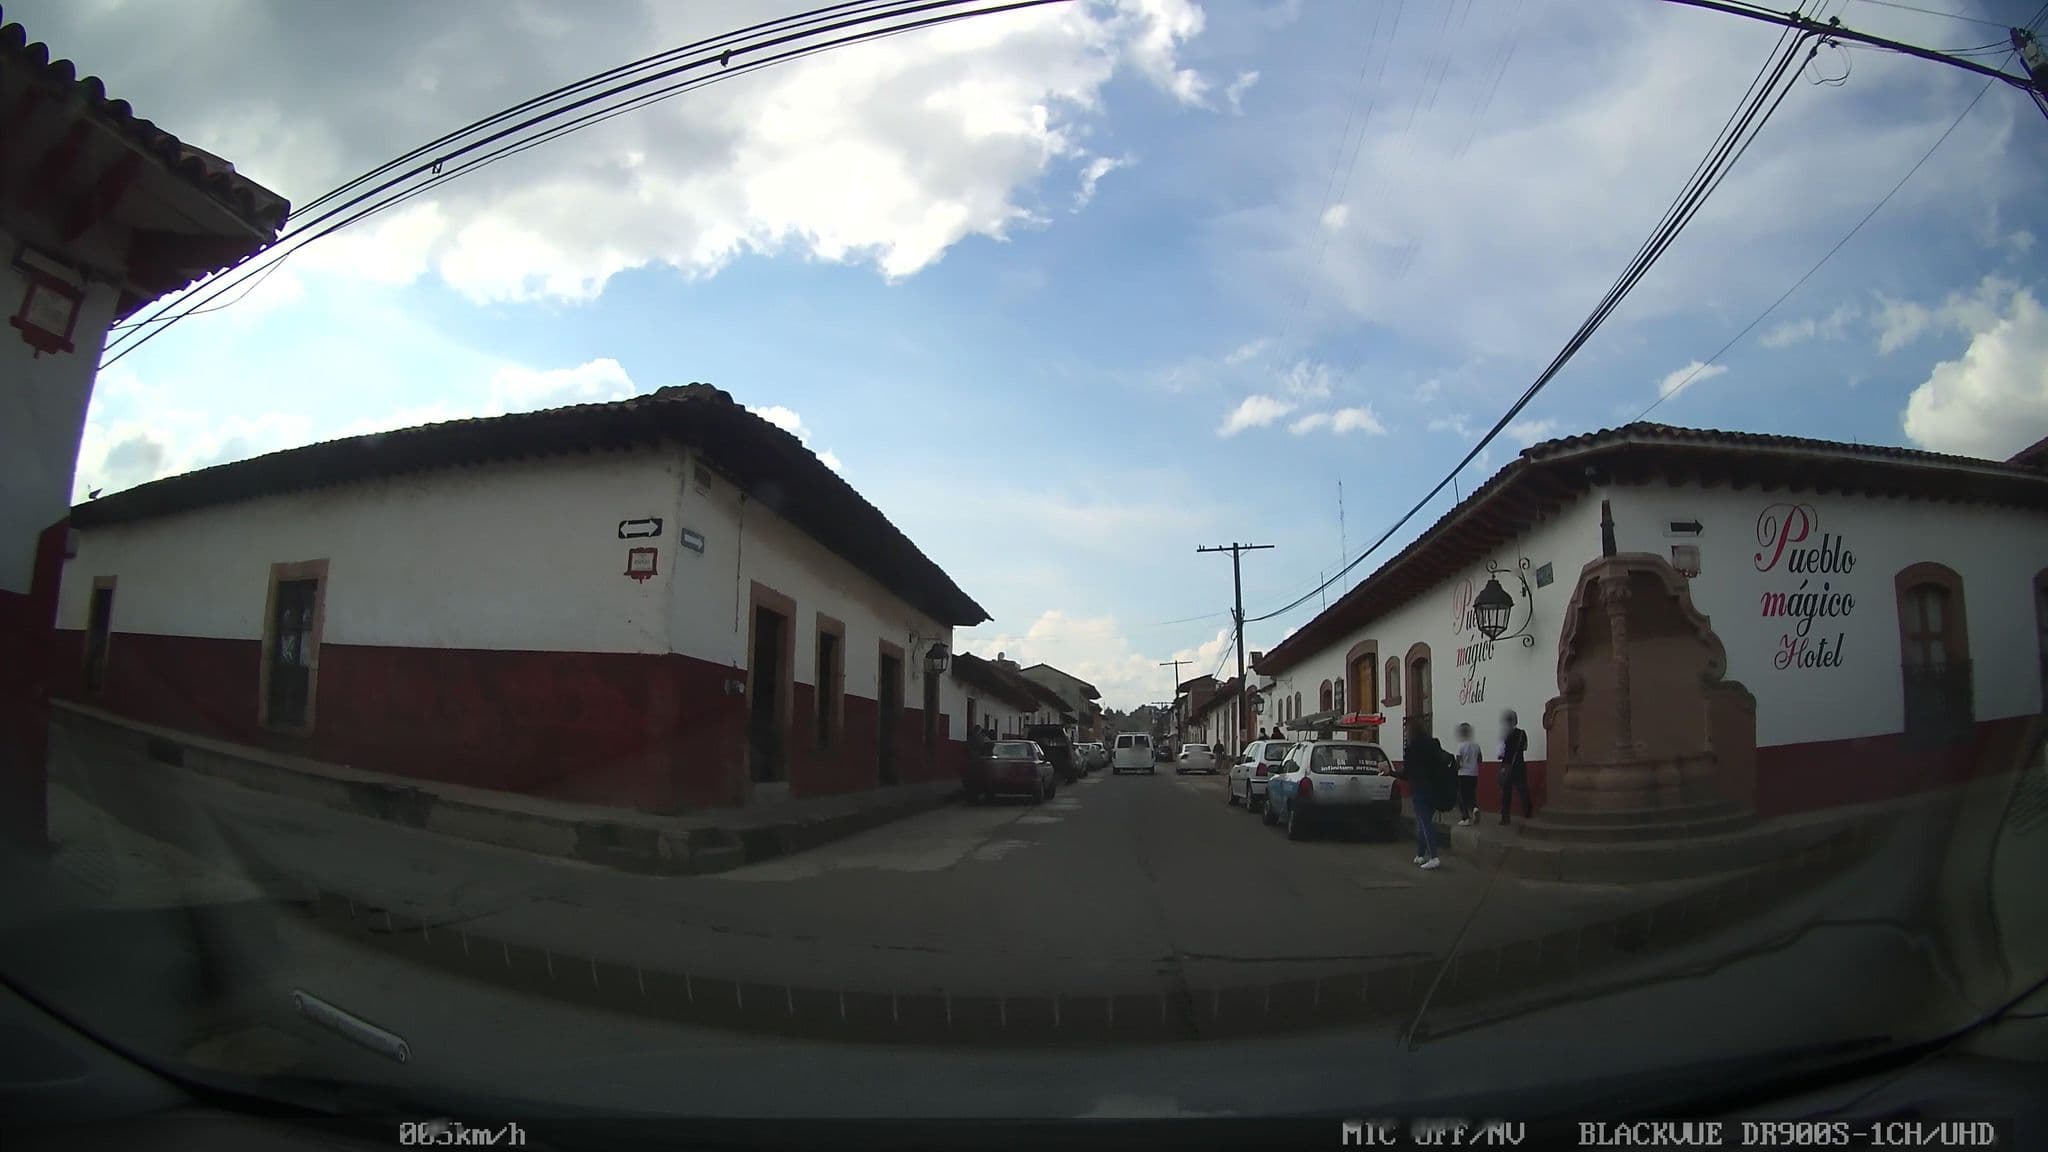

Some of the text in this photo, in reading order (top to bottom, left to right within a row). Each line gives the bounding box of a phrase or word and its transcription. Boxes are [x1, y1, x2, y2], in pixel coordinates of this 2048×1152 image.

[1754, 503, 1856, 574] Pueblo
[1761, 579, 1856, 637] mágico
[1456, 634, 1494, 681] mágico
[1774, 633, 1844, 670] Hotel
[1459, 677, 1486, 705] Hotel
